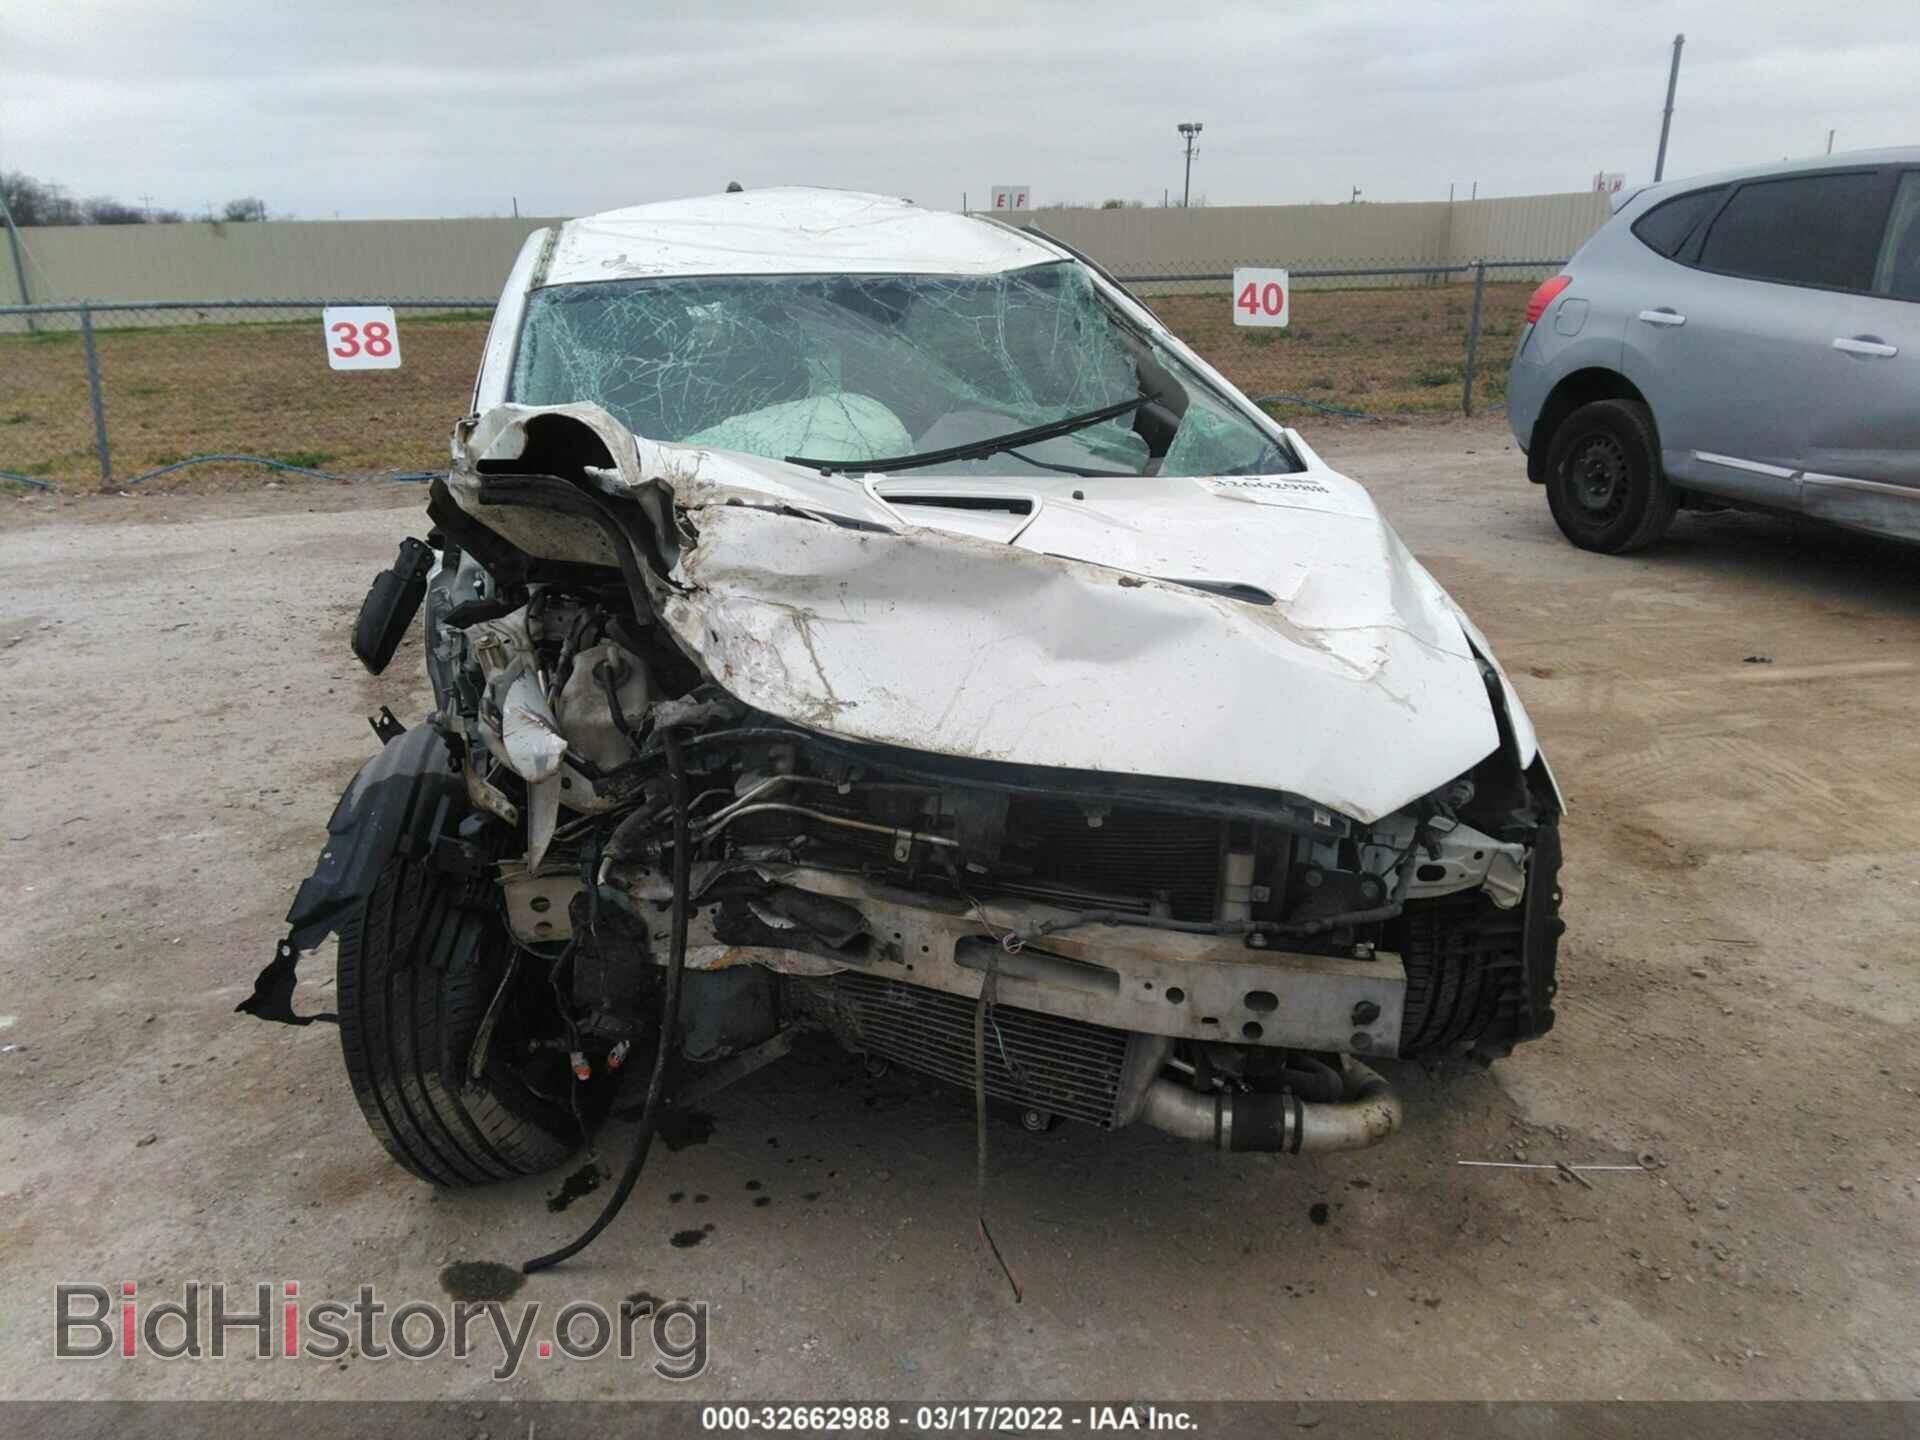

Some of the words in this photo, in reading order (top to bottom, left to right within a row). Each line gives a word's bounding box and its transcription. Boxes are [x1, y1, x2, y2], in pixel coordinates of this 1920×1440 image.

[996, 194, 1006, 208] E
[1016, 194, 1025, 208] F
[1237, 282, 1285, 317] 40
[331, 321, 393, 359] 38
